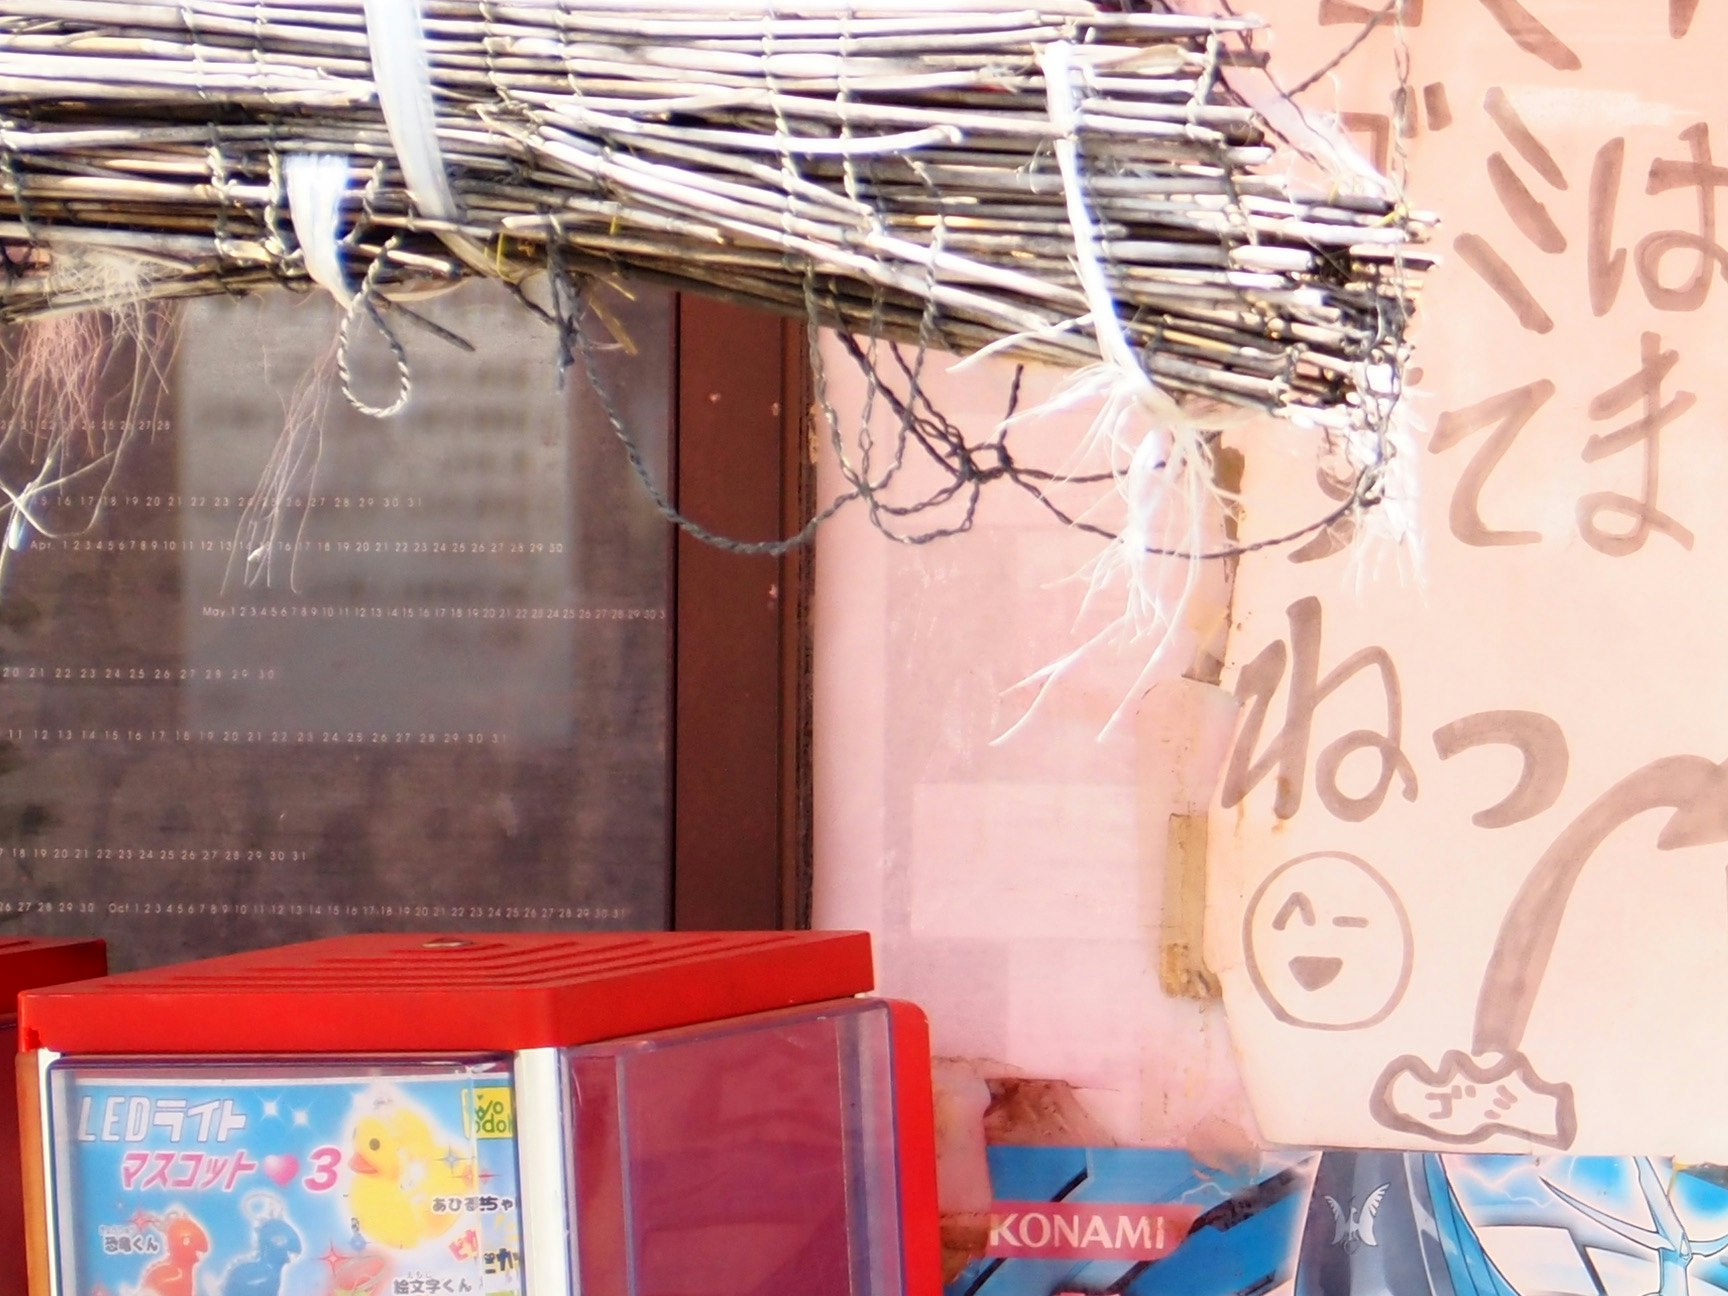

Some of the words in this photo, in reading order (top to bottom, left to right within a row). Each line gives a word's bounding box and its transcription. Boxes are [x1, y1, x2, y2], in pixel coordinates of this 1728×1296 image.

[77, 1095, 248, 1143] LEDライト
[121, 1150, 257, 1191] マスコット
[304, 1146, 342, 1192] 3
[989, 1213, 1166, 1250] KONAMI
[394, 1278, 472, 1295] 絵文字くん
